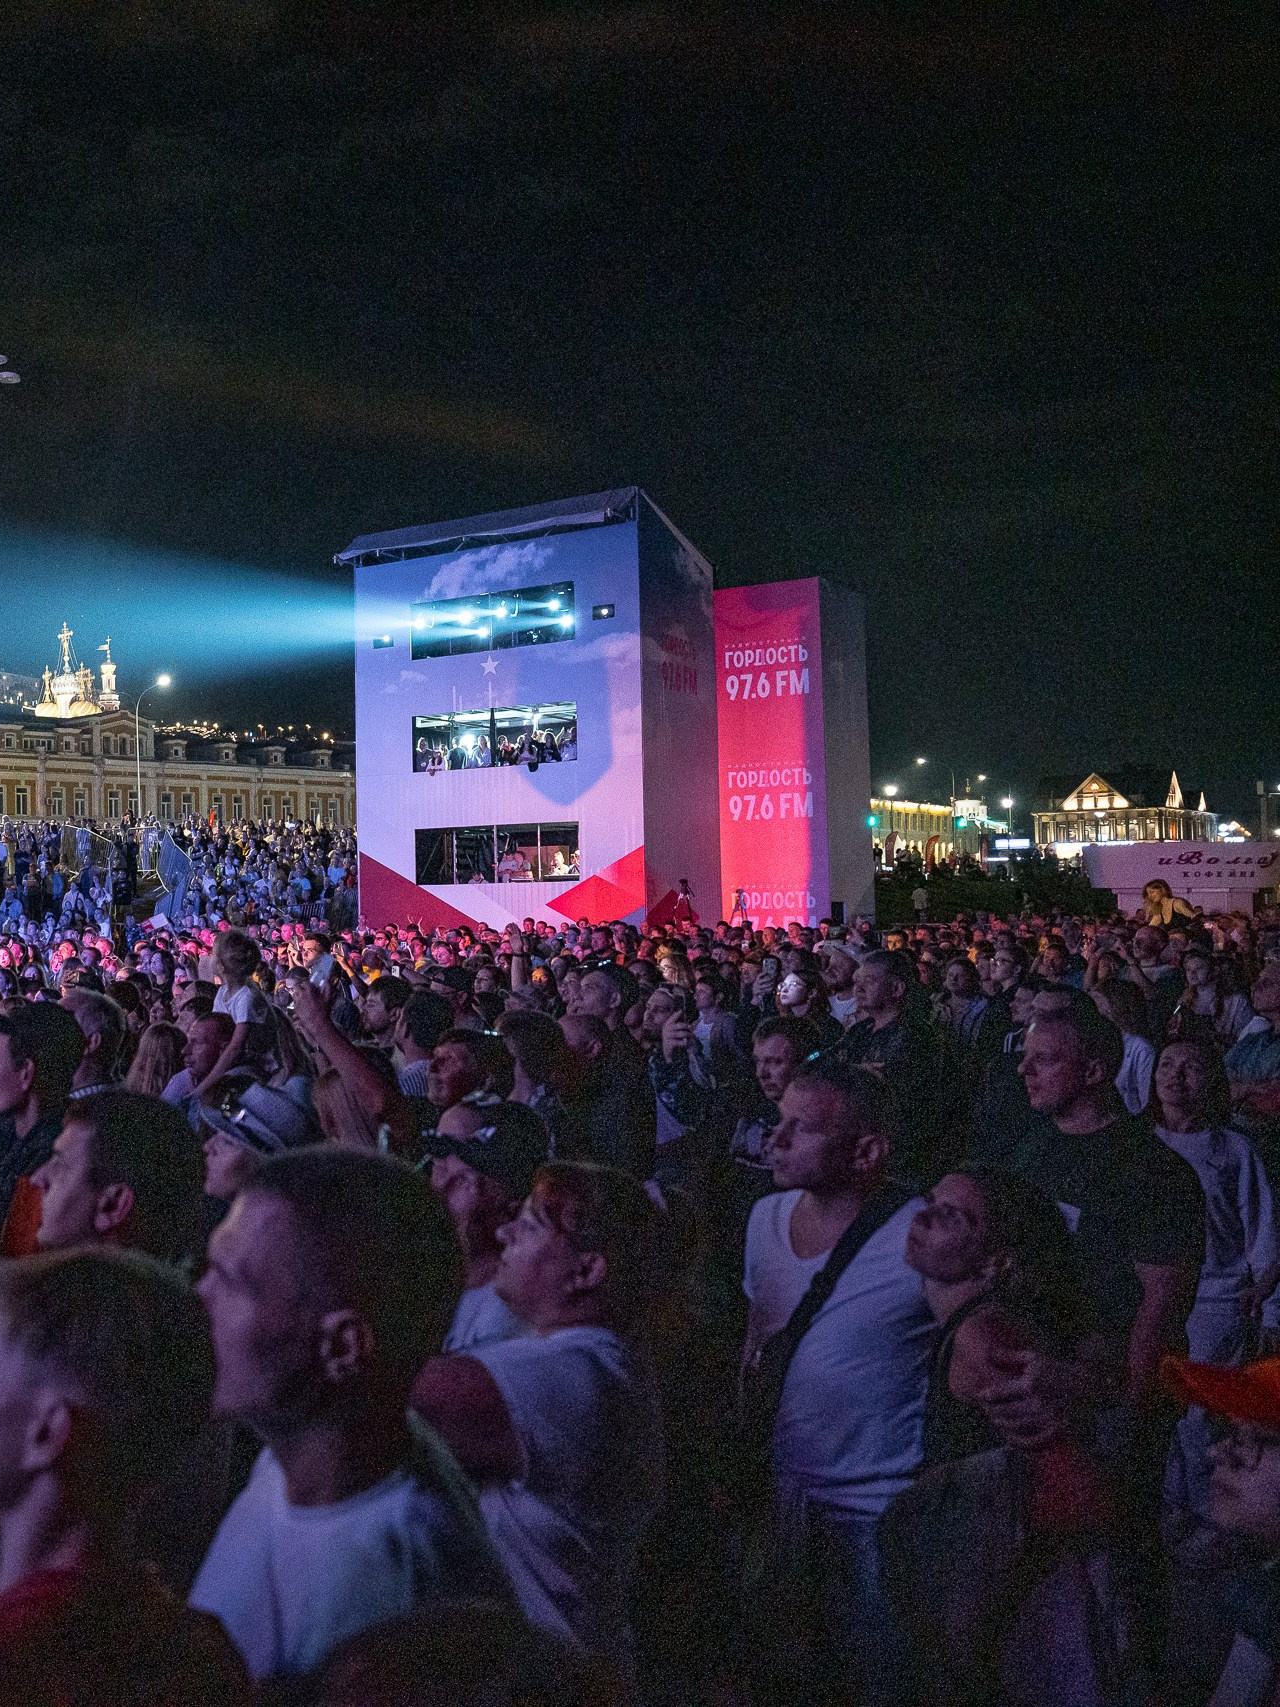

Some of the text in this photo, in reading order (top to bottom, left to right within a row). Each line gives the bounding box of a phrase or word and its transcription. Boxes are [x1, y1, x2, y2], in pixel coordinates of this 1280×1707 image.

[724, 644, 808, 669] ГОРДОСТЬ
[726, 668, 809, 701] 97.6 FM
[727, 767, 813, 789] ГОРДОСТЬ
[729, 792, 814, 821] 97.6 FM
